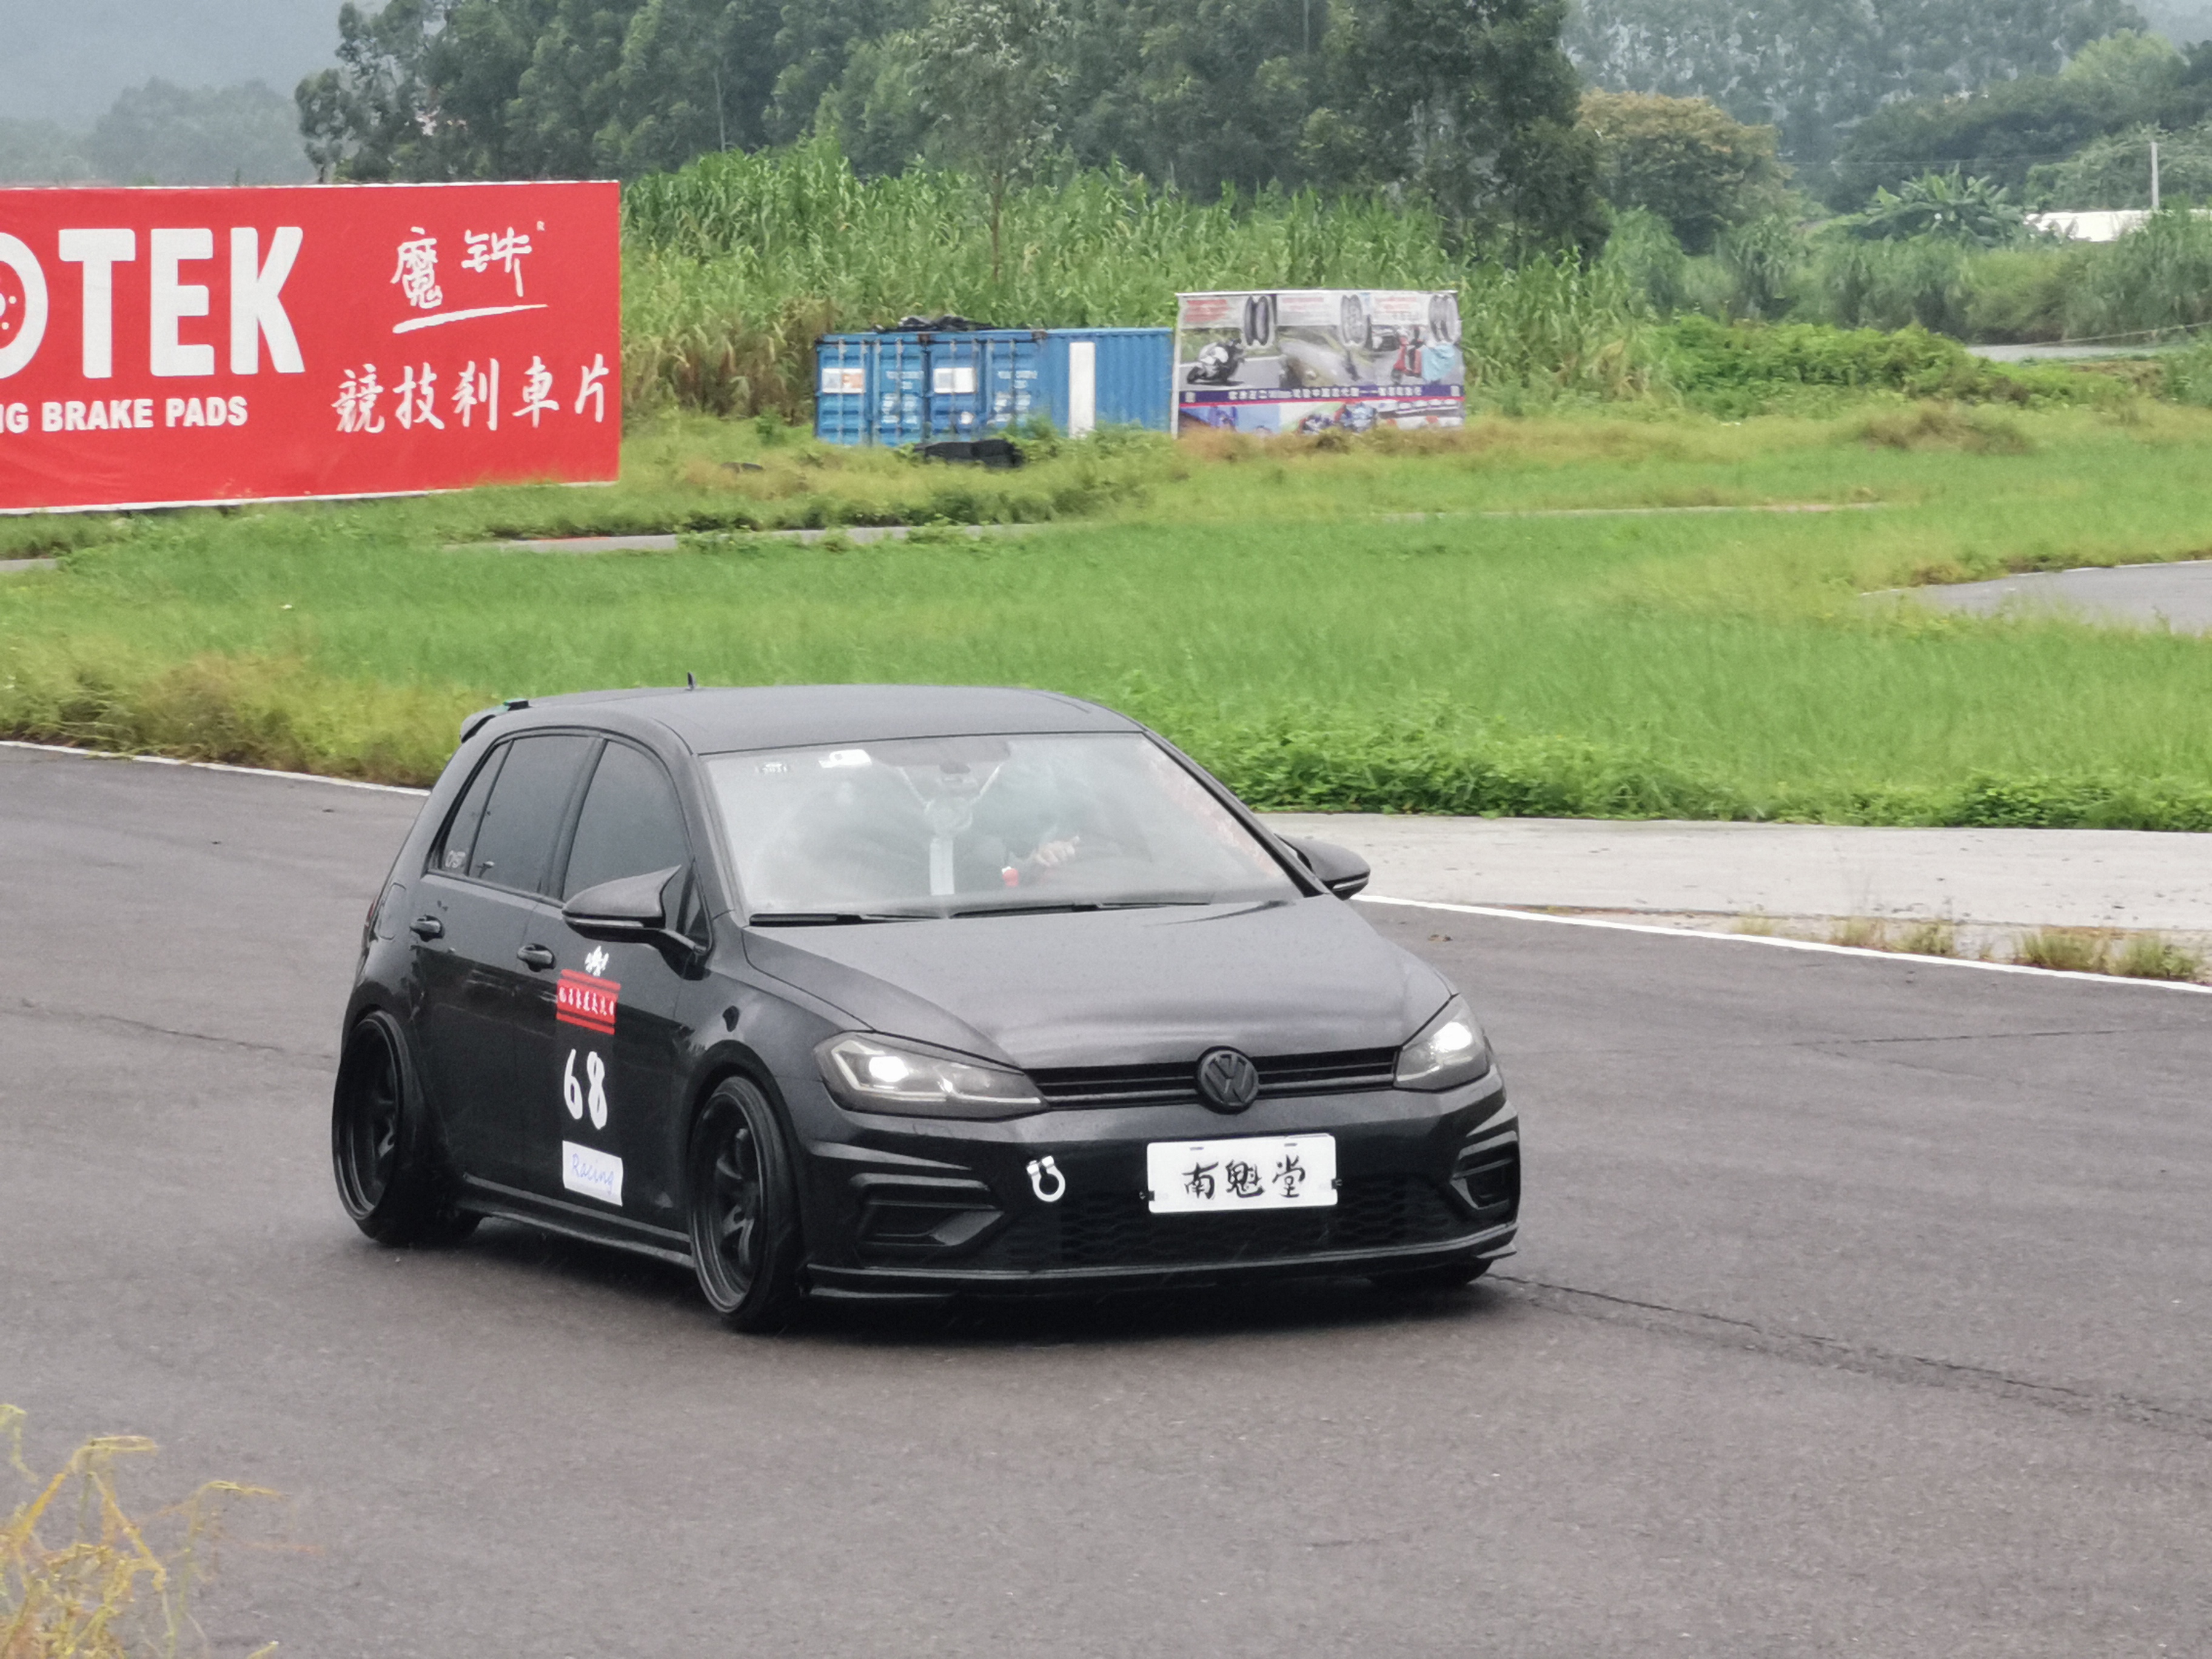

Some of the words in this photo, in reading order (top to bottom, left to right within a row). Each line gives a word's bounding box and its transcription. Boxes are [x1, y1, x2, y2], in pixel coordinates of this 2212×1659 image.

[42, 398, 154, 432] BRAKE
[166, 396, 248, 427] PADS
[564, 1048, 608, 1130] 68
[1182, 1154, 1307, 1200] 南魁堂
